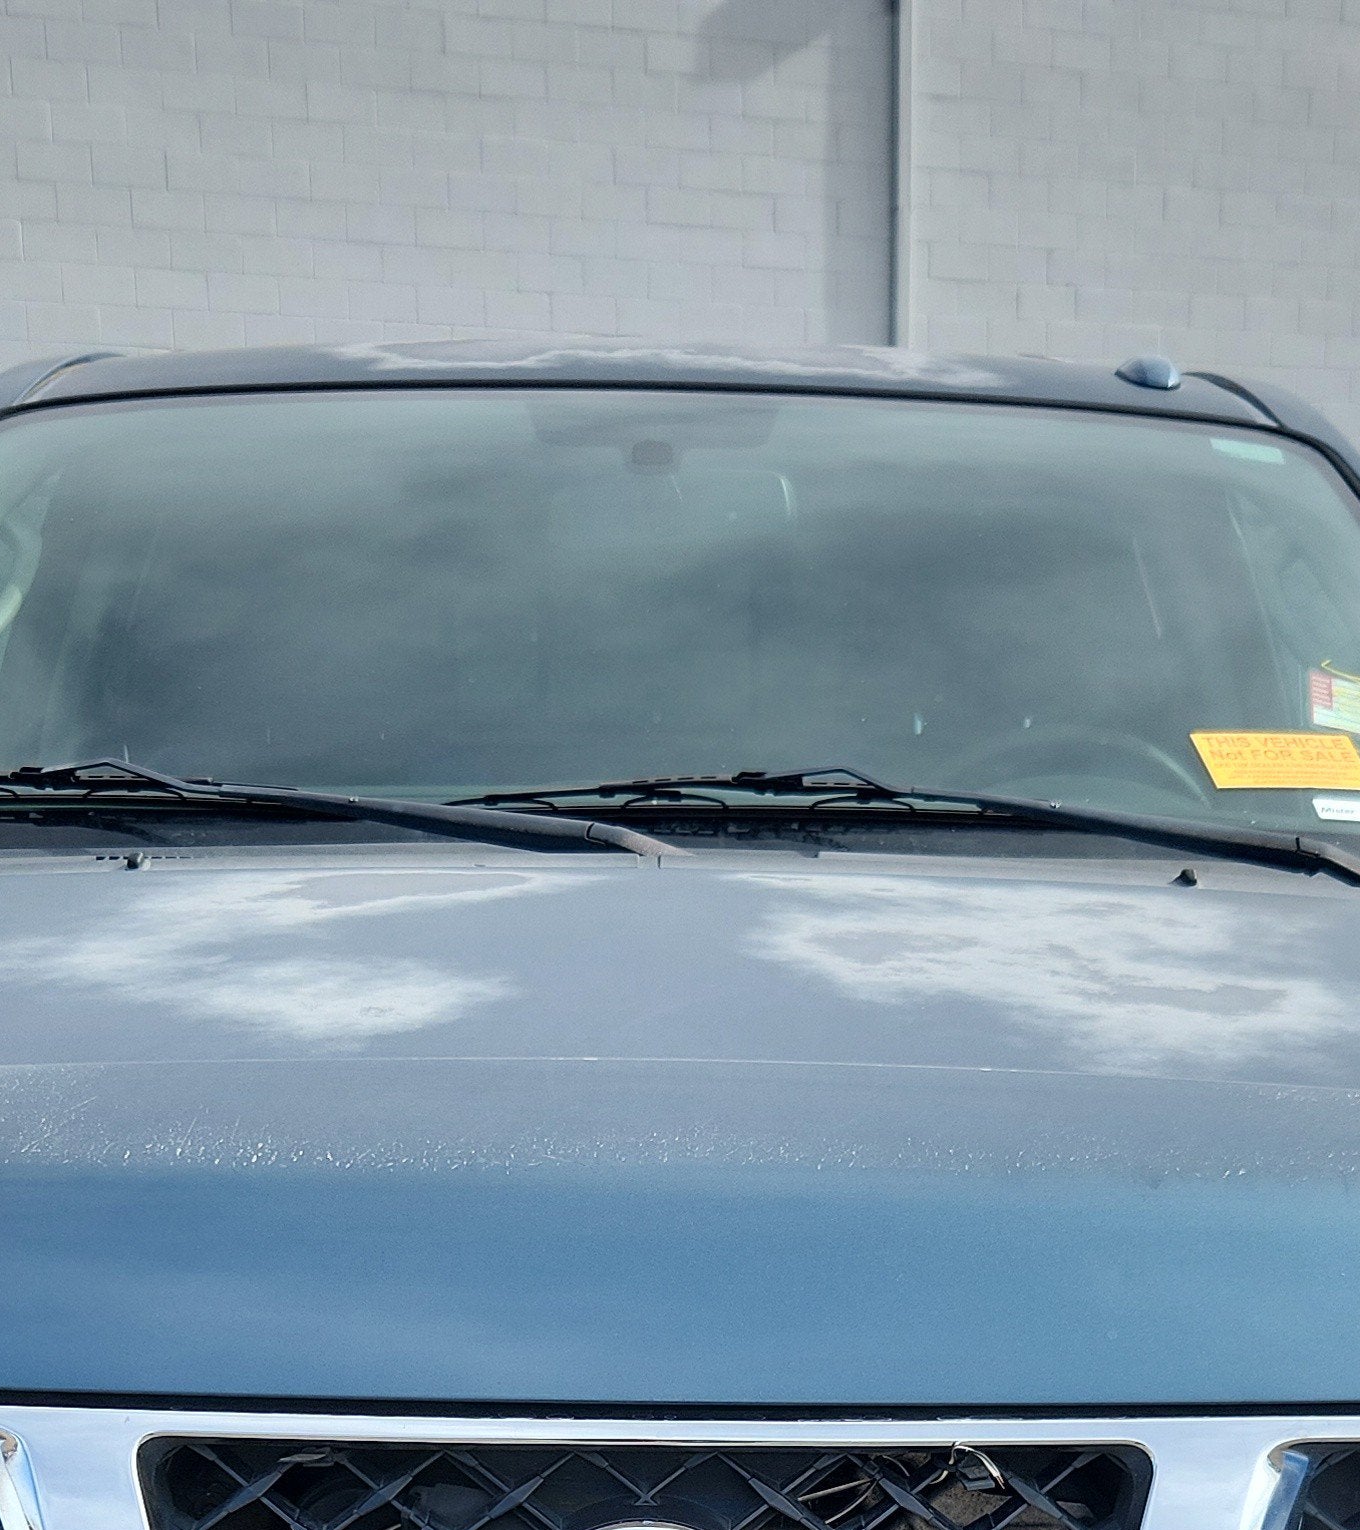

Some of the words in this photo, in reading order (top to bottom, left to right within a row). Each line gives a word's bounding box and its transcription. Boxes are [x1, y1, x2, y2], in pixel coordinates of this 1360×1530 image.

[1201, 737, 1250, 748] THIS
[1257, 738, 1345, 749] VEHICLE
[1252, 750, 1294, 761] FOR
[1302, 751, 1356, 763] SALE
